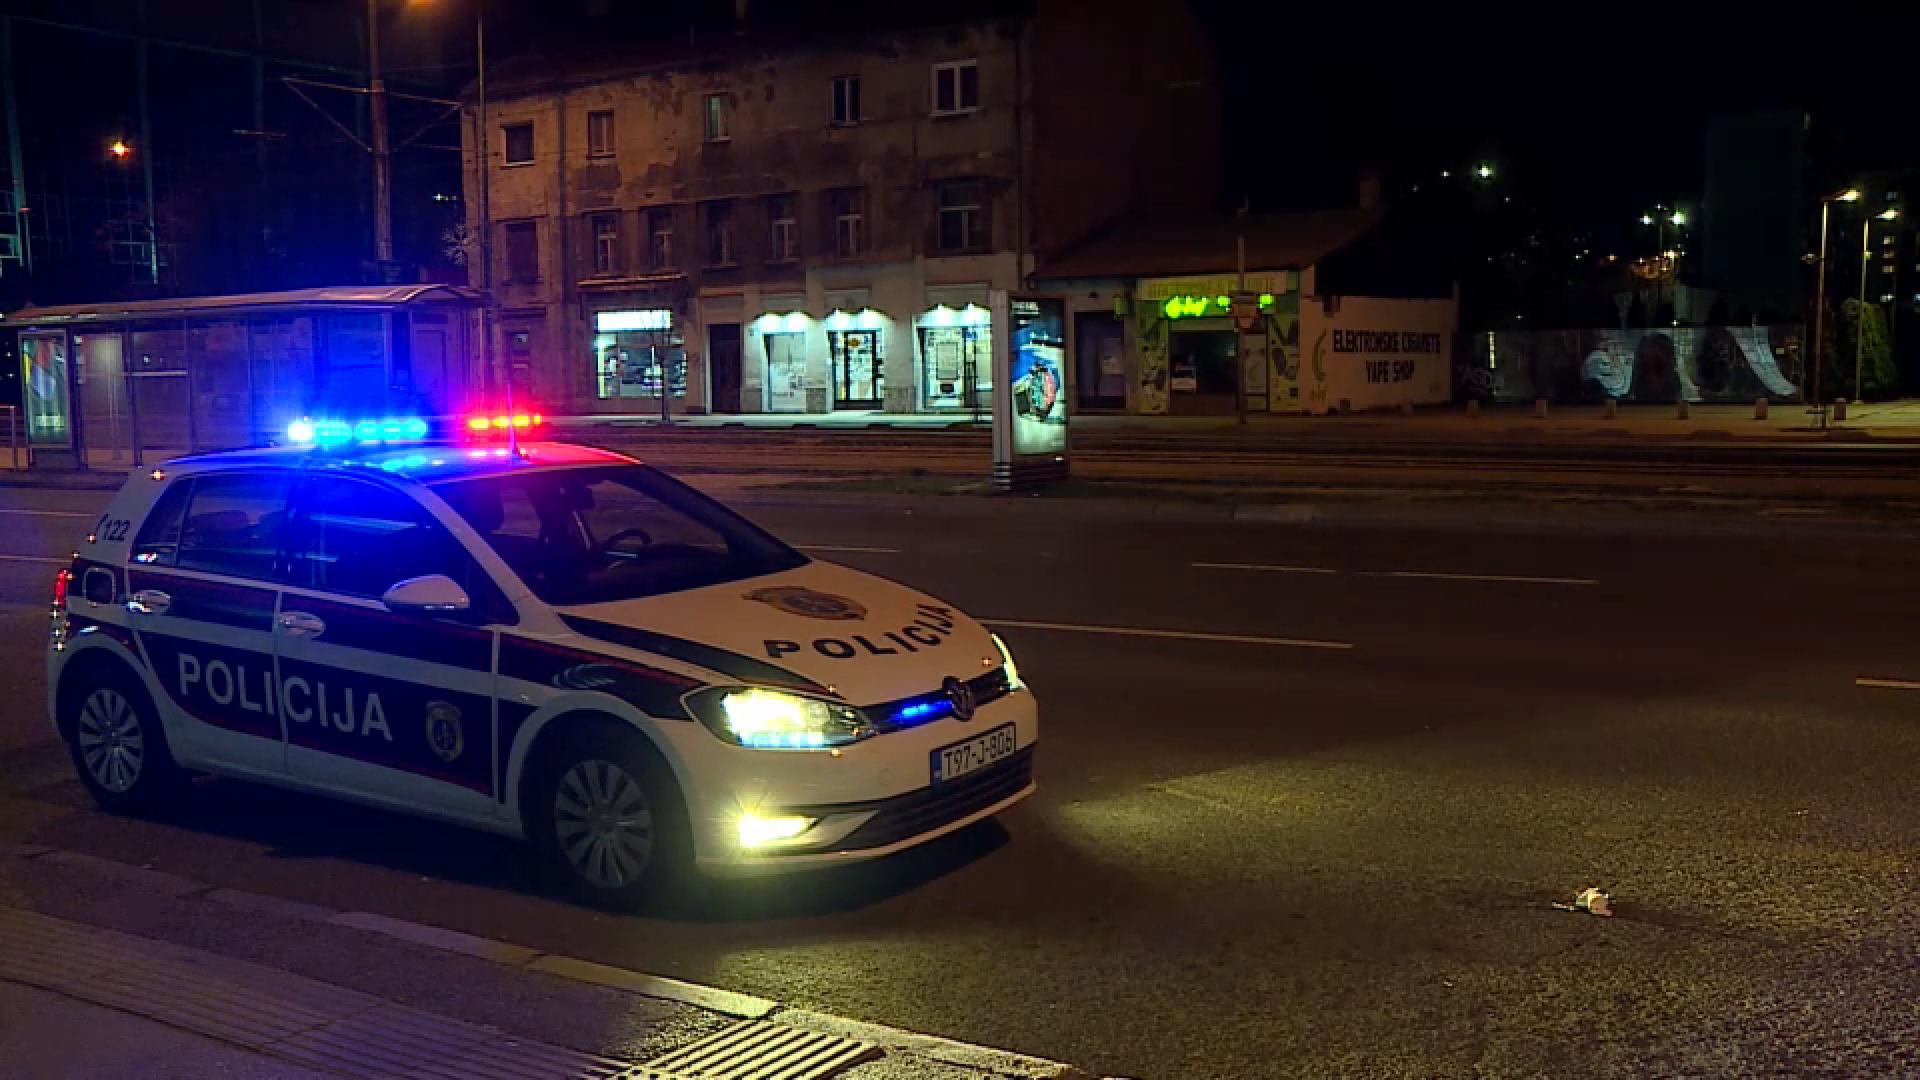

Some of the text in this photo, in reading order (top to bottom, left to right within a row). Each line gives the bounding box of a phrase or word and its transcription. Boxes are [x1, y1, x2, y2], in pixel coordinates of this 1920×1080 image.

[1365, 359, 1415, 384] VAPE SHOP
[102, 519, 131, 541] 122
[764, 603, 953, 659] POLICIJA
[177, 652, 393, 741] POLICIJA
[943, 728, 1013, 777] T97-J-806
